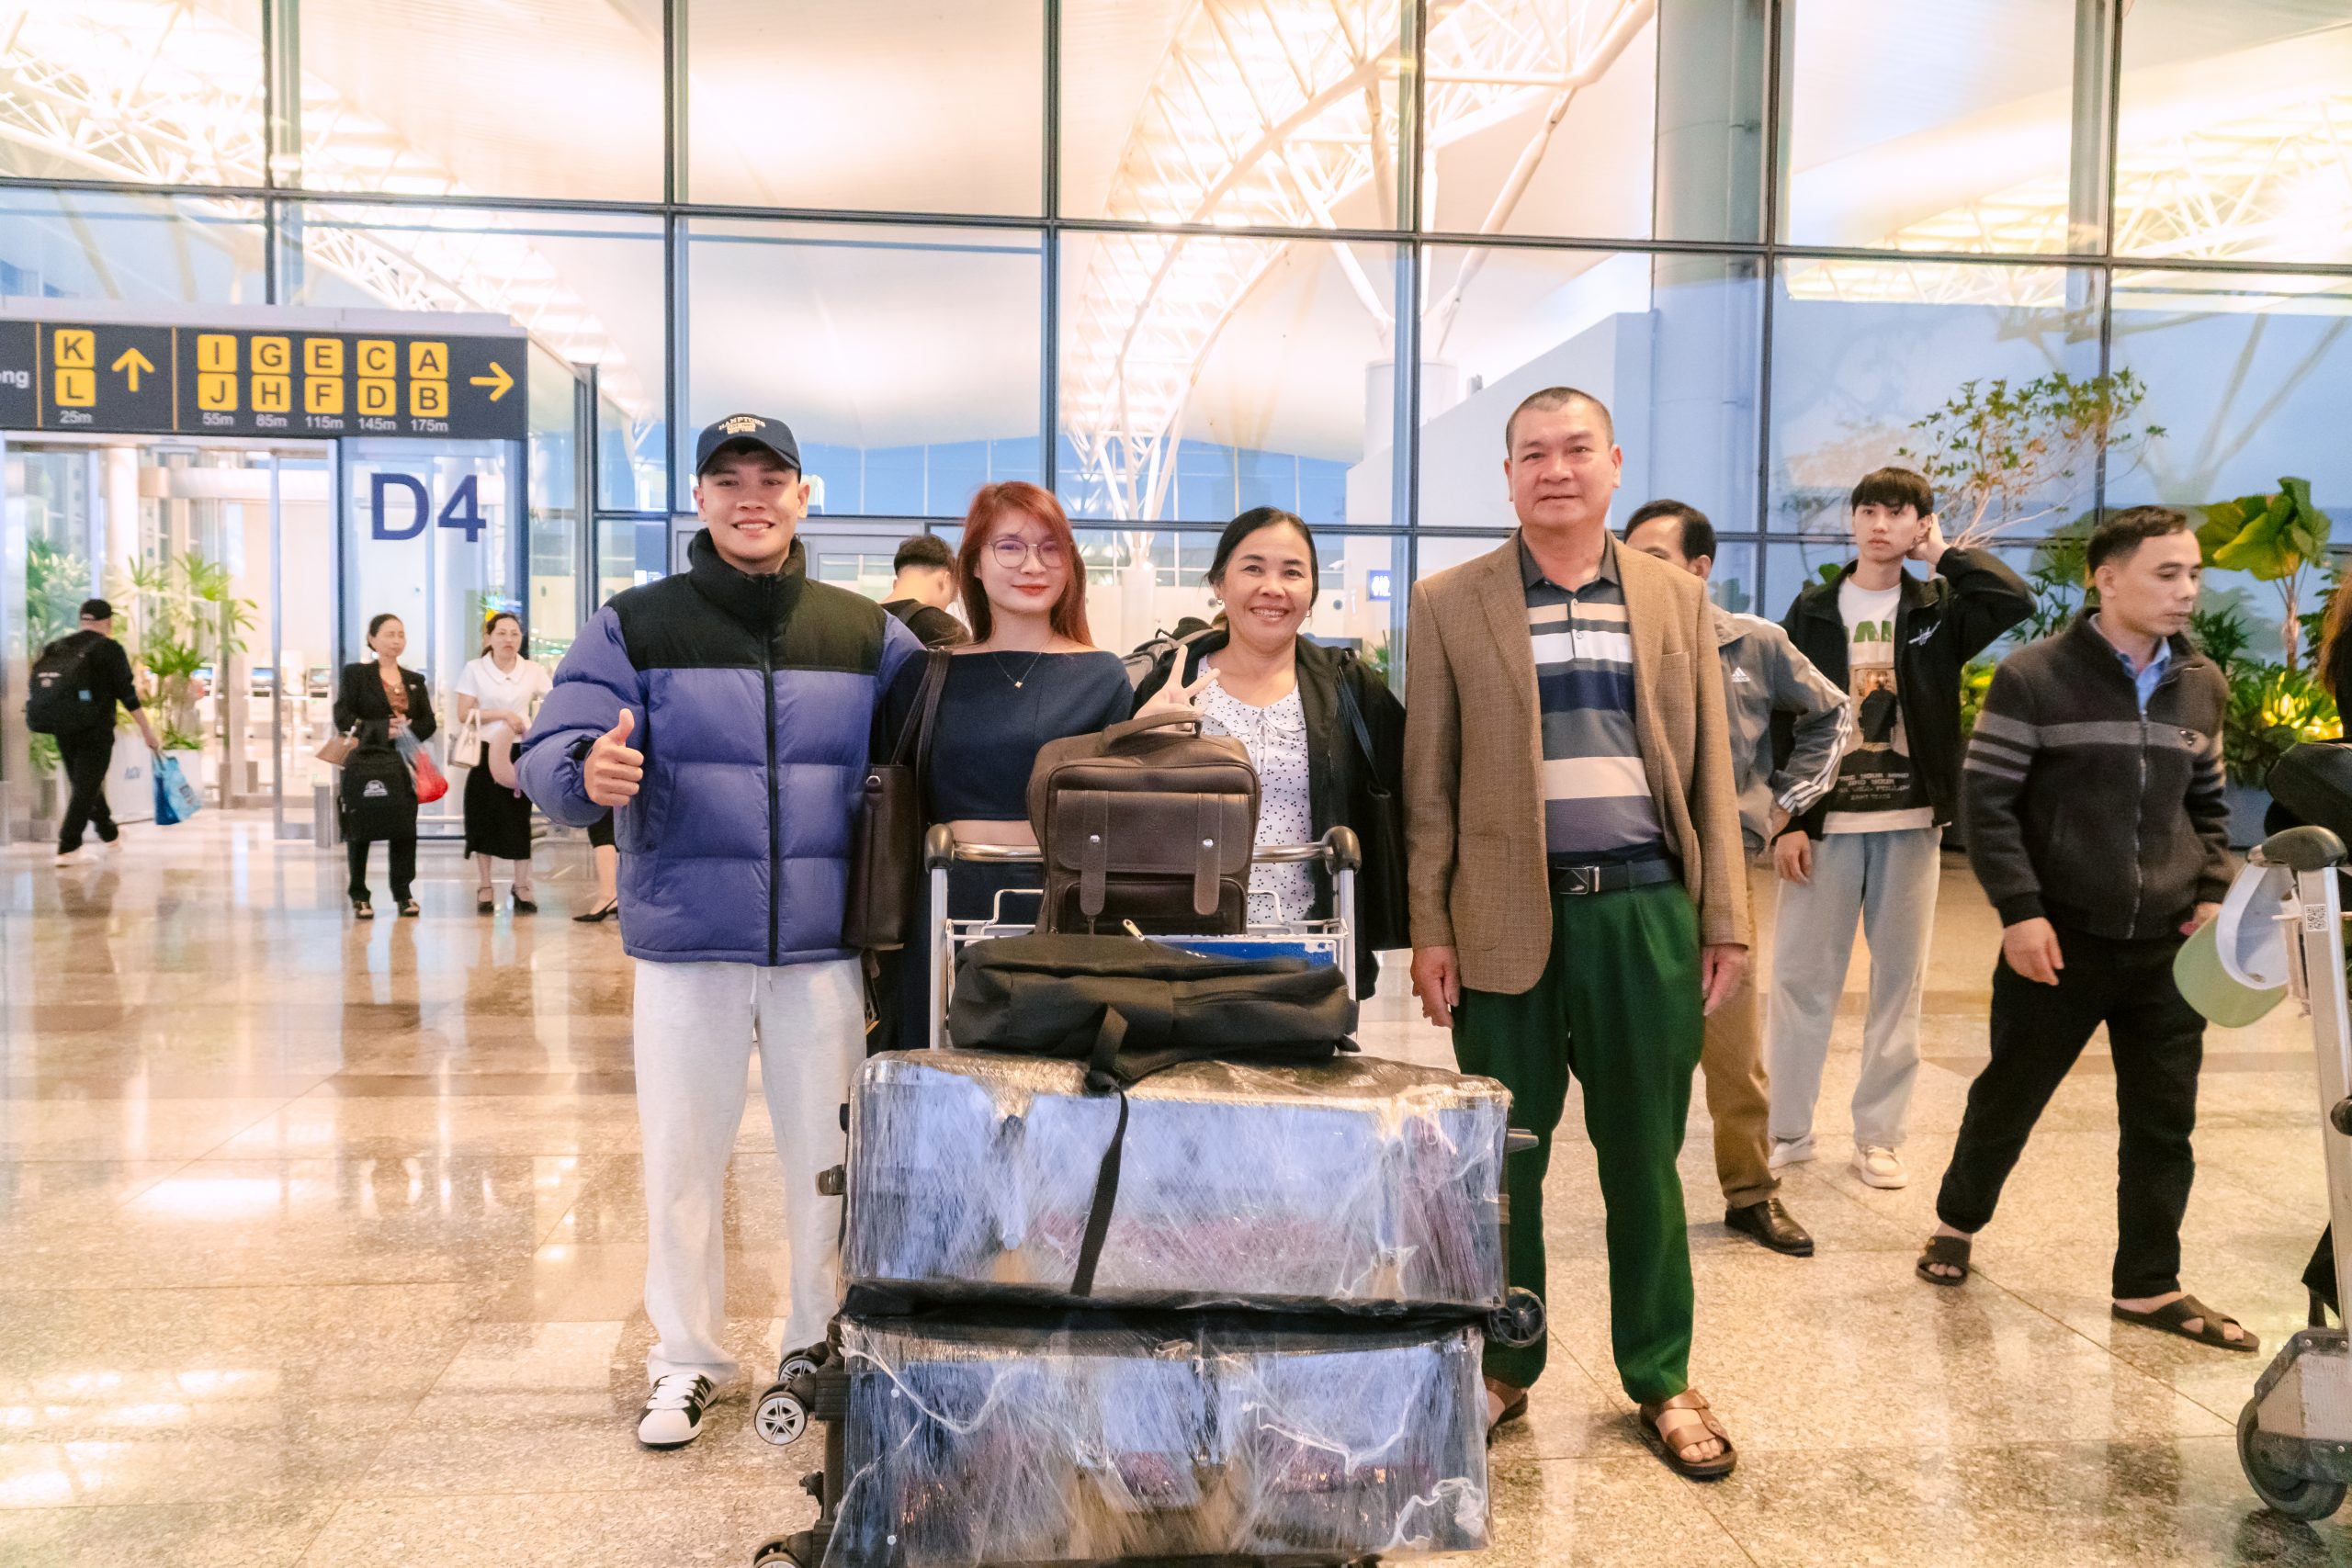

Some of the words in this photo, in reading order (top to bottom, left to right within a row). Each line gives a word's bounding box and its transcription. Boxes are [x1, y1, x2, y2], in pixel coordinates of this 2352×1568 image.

[63, 336, 85, 361] K
[214, 341, 220, 366] I
[259, 343, 282, 367] G
[314, 344, 333, 369] E
[366, 346, 387, 370] C
[416, 348, 440, 373] A
[0, 369, 30, 389] ng
[66, 376, 84, 400] L
[209, 379, 225, 404] J
[261, 381, 280, 406] H
[315, 383, 332, 407] F
[367, 385, 386, 409] D
[418, 386, 439, 411] B
[59, 410, 93, 424] 25m
[202, 412, 235, 426] 55m
[255, 413, 288, 428] 85m
[305, 415, 345, 430] 115m
[357, 417, 397, 431] 145m
[410, 418, 449, 433] 175m
[370, 472, 487, 543] D4
